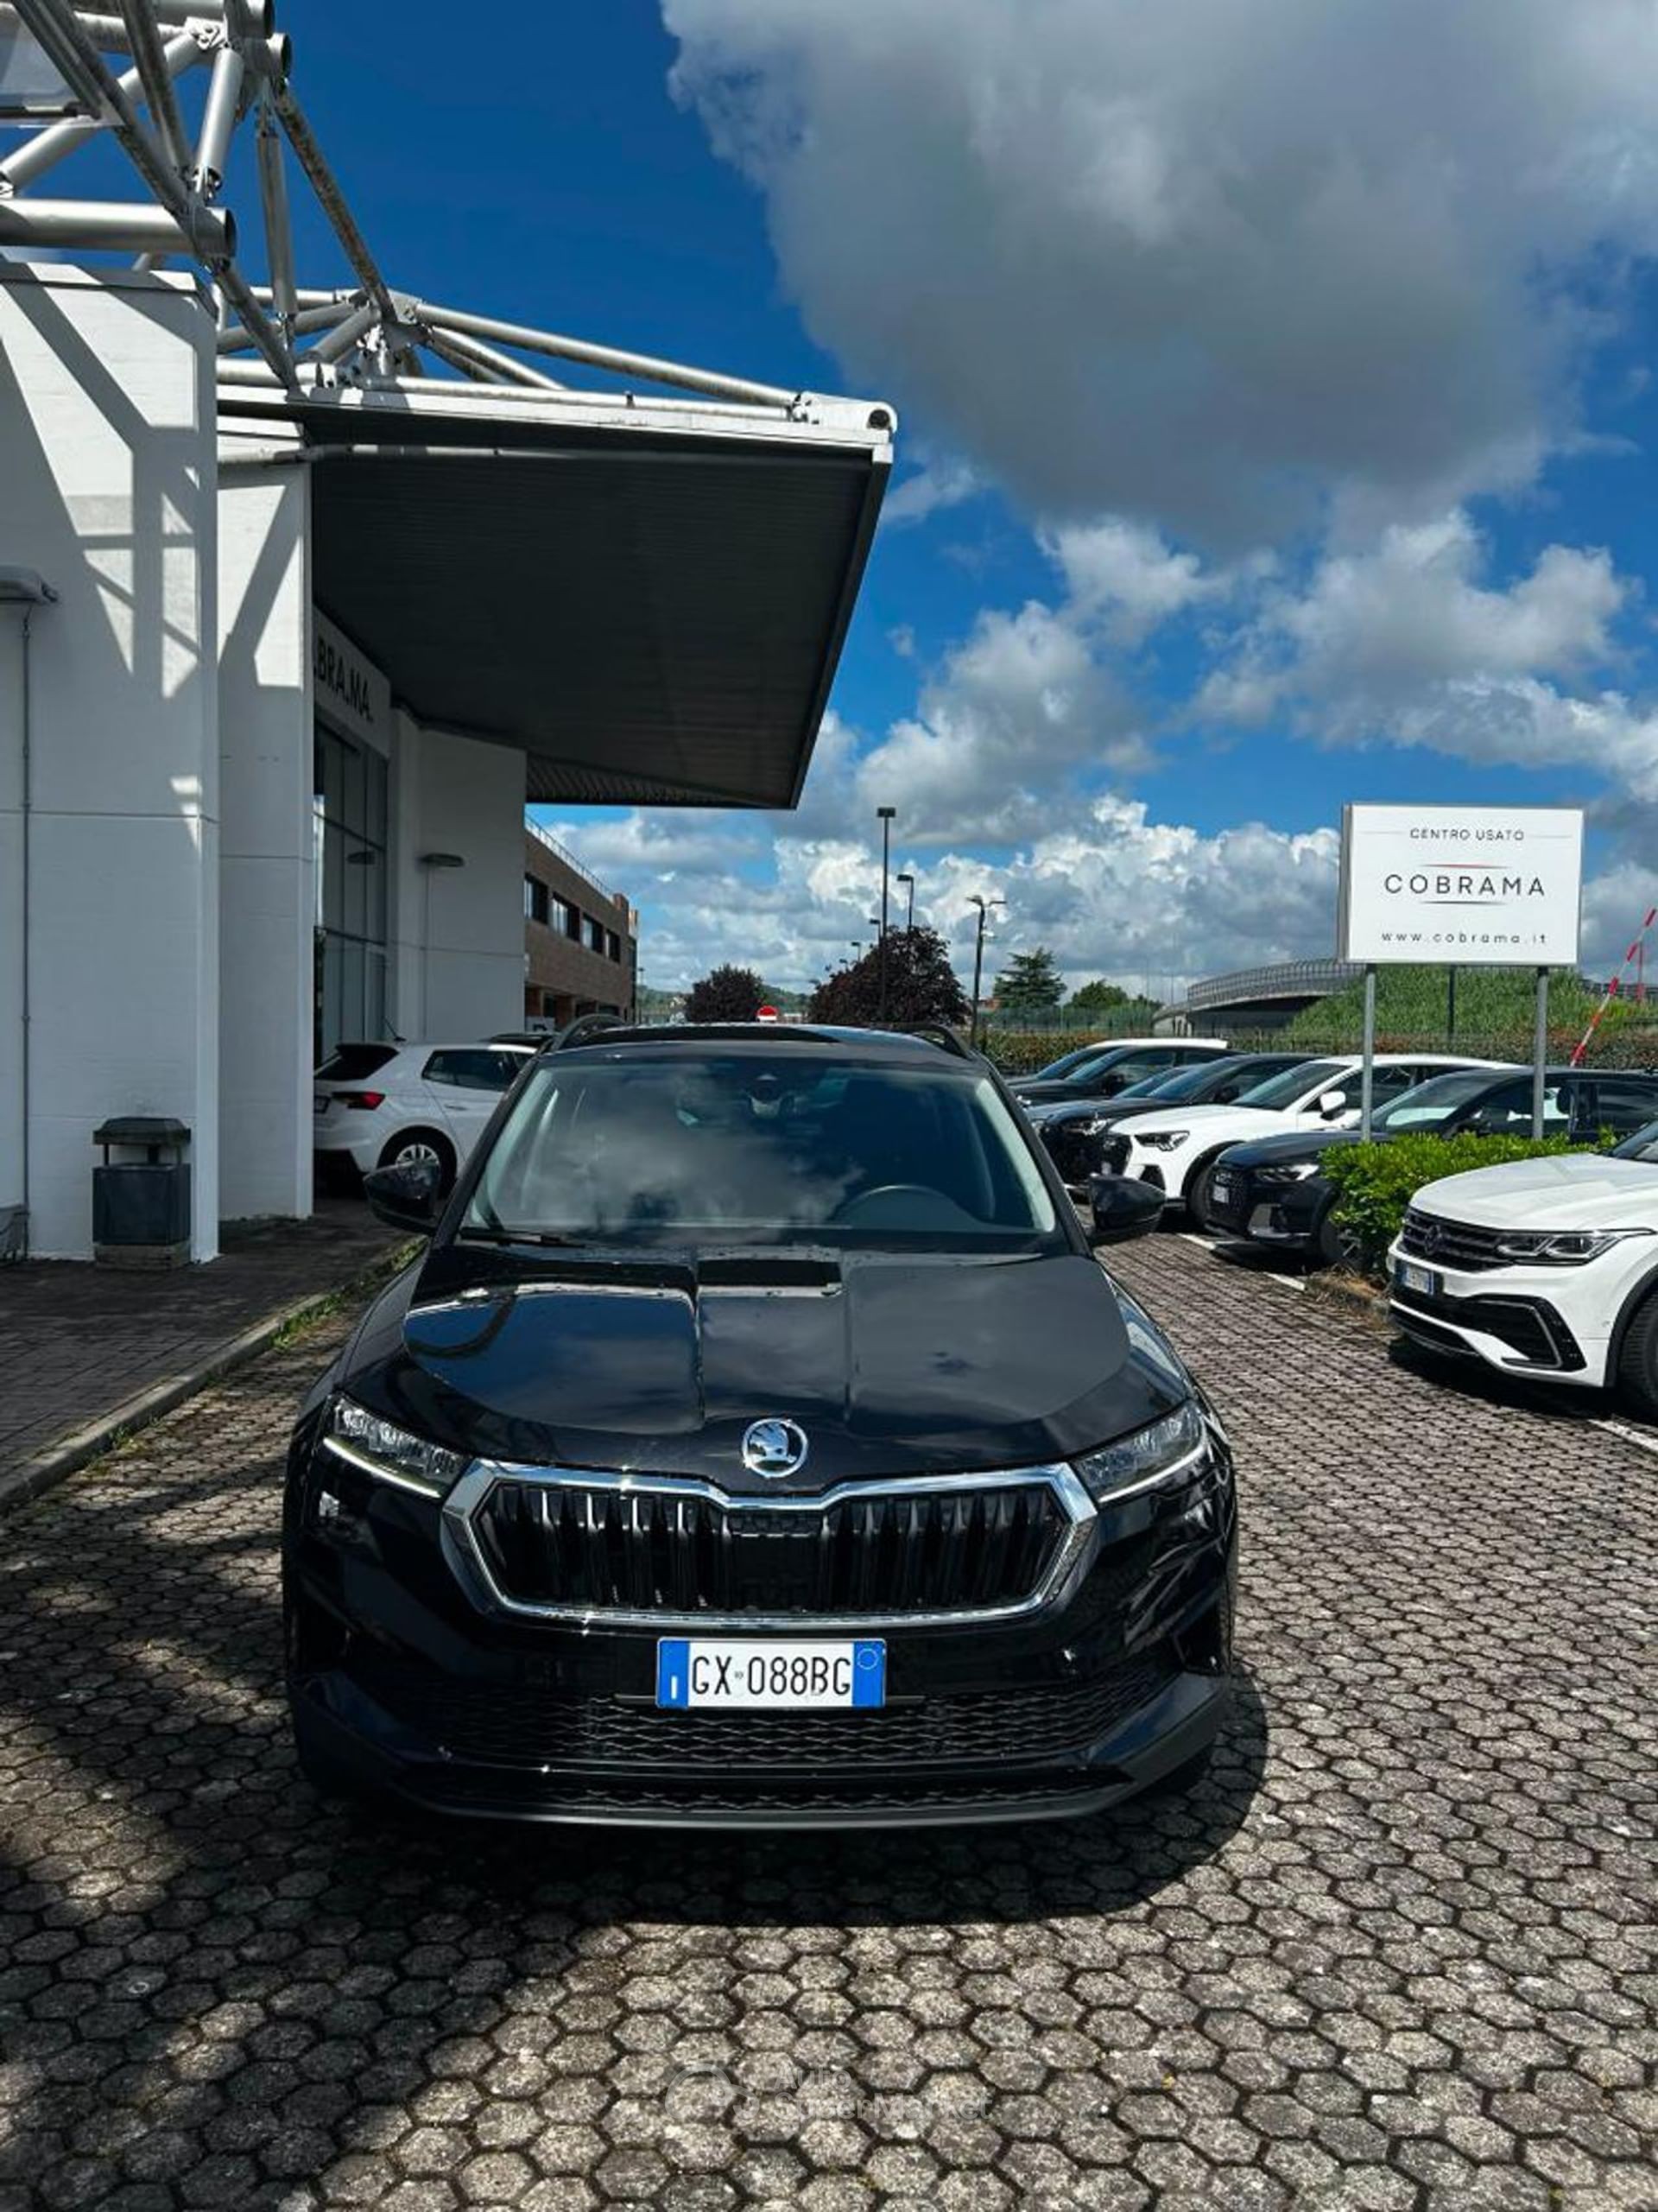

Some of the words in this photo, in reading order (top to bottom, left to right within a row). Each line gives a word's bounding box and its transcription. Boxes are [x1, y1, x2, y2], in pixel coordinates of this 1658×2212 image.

[1409, 827, 1471, 841] CENTRO
[1475, 828, 1525, 841] USATO
[1383, 873, 1546, 897] COBRAMA
[1381, 932, 1547, 945] www.cobrama.it
[692, 1655, 731, 1695] GX
[748, 1656, 851, 1696] 088BG
